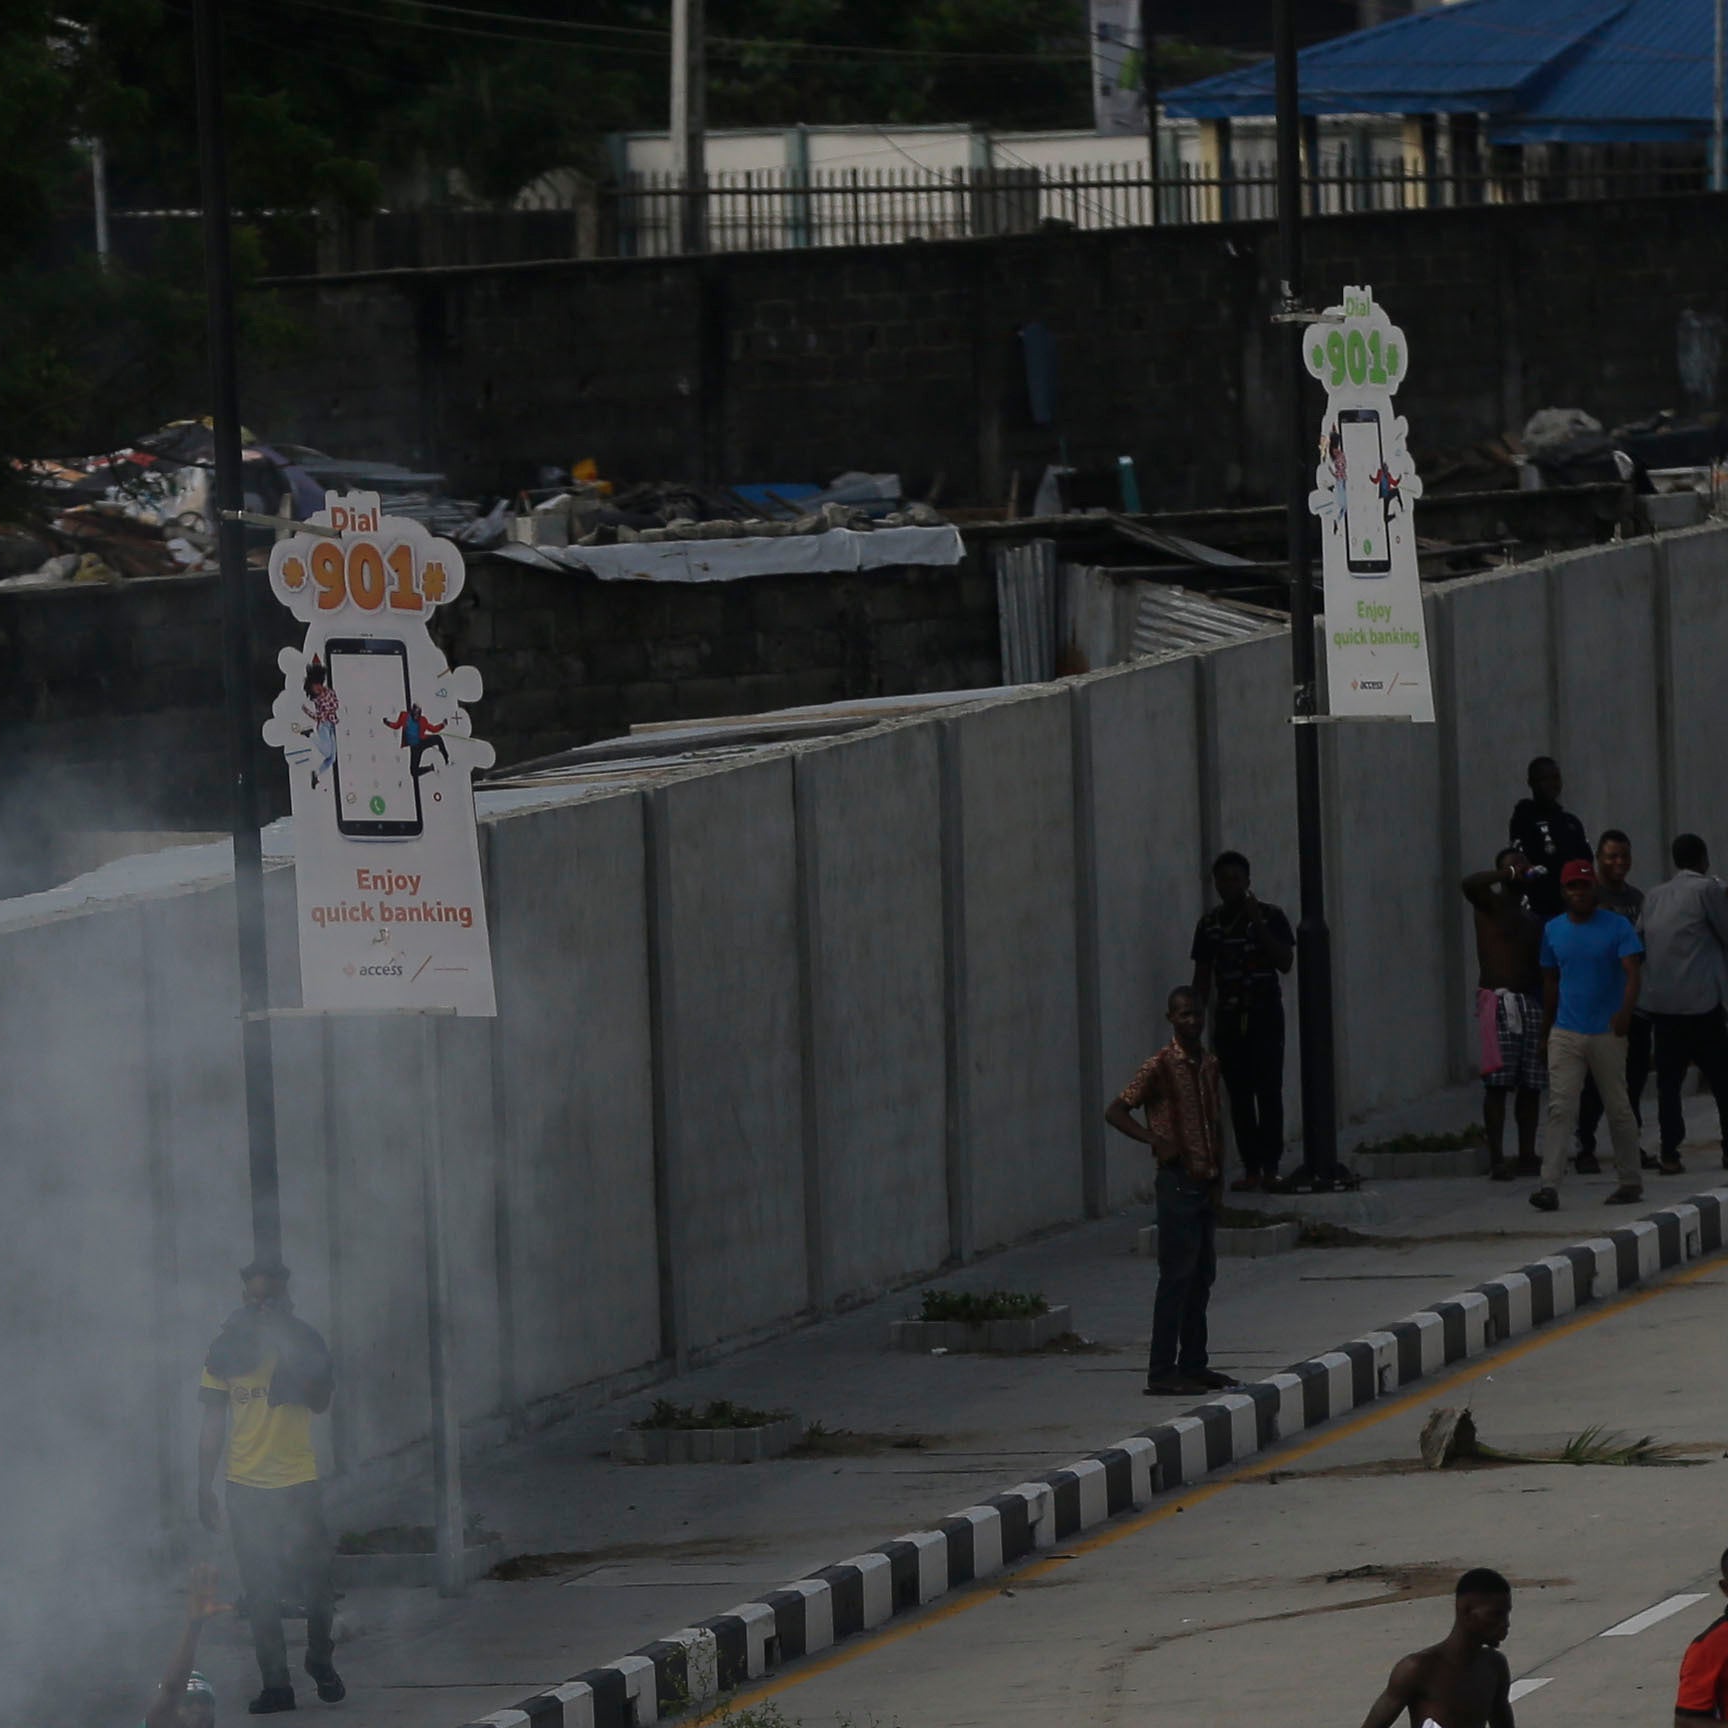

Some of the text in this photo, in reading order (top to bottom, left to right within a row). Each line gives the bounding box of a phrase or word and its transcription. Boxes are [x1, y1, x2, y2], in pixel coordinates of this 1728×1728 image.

[1345, 296, 1370, 317] Dial
[331, 506, 378, 532] Dial
[1357, 600, 1392, 623] Enjoy
[1333, 627, 1420, 649] quick banking
[356, 868, 422, 896] Enjoy
[311, 900, 473, 929] quick banking
[359, 964, 403, 976] access
